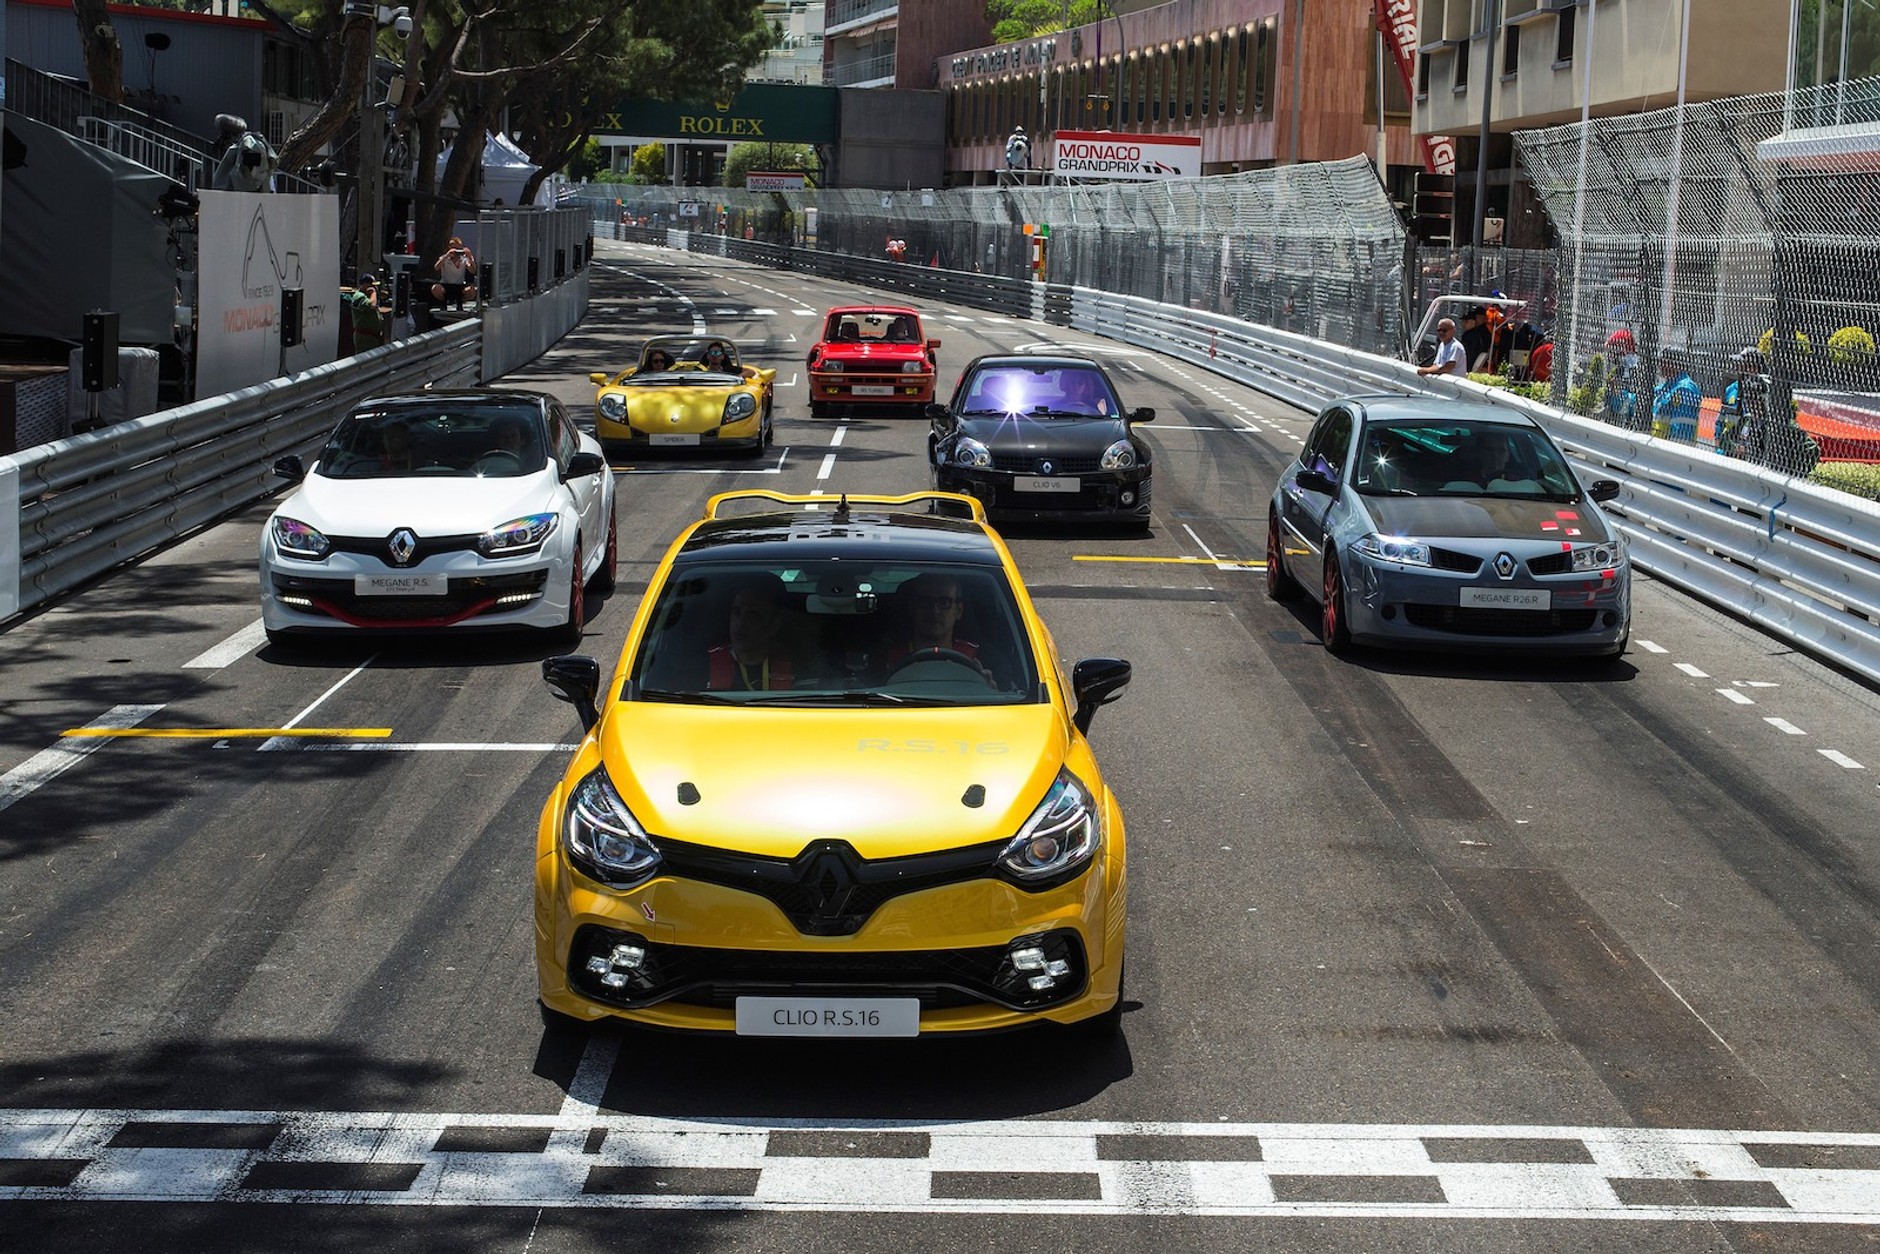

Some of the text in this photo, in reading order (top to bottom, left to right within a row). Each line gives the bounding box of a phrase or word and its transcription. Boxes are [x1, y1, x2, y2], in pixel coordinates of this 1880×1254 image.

[679, 116, 764, 136] ROLEX
[1059, 143, 1140, 161] MONACO
[1058, 158, 1139, 173] GRANDPRIX
[223, 303, 273, 334] MONACO
[1032, 481, 1050, 489] CLIO
[371, 578, 411, 587] MEGANE
[1473, 593, 1511, 603] MEGANE
[857, 738, 1010, 756] R.S.16
[773, 1009, 880, 1027] CLIO R.S.16
